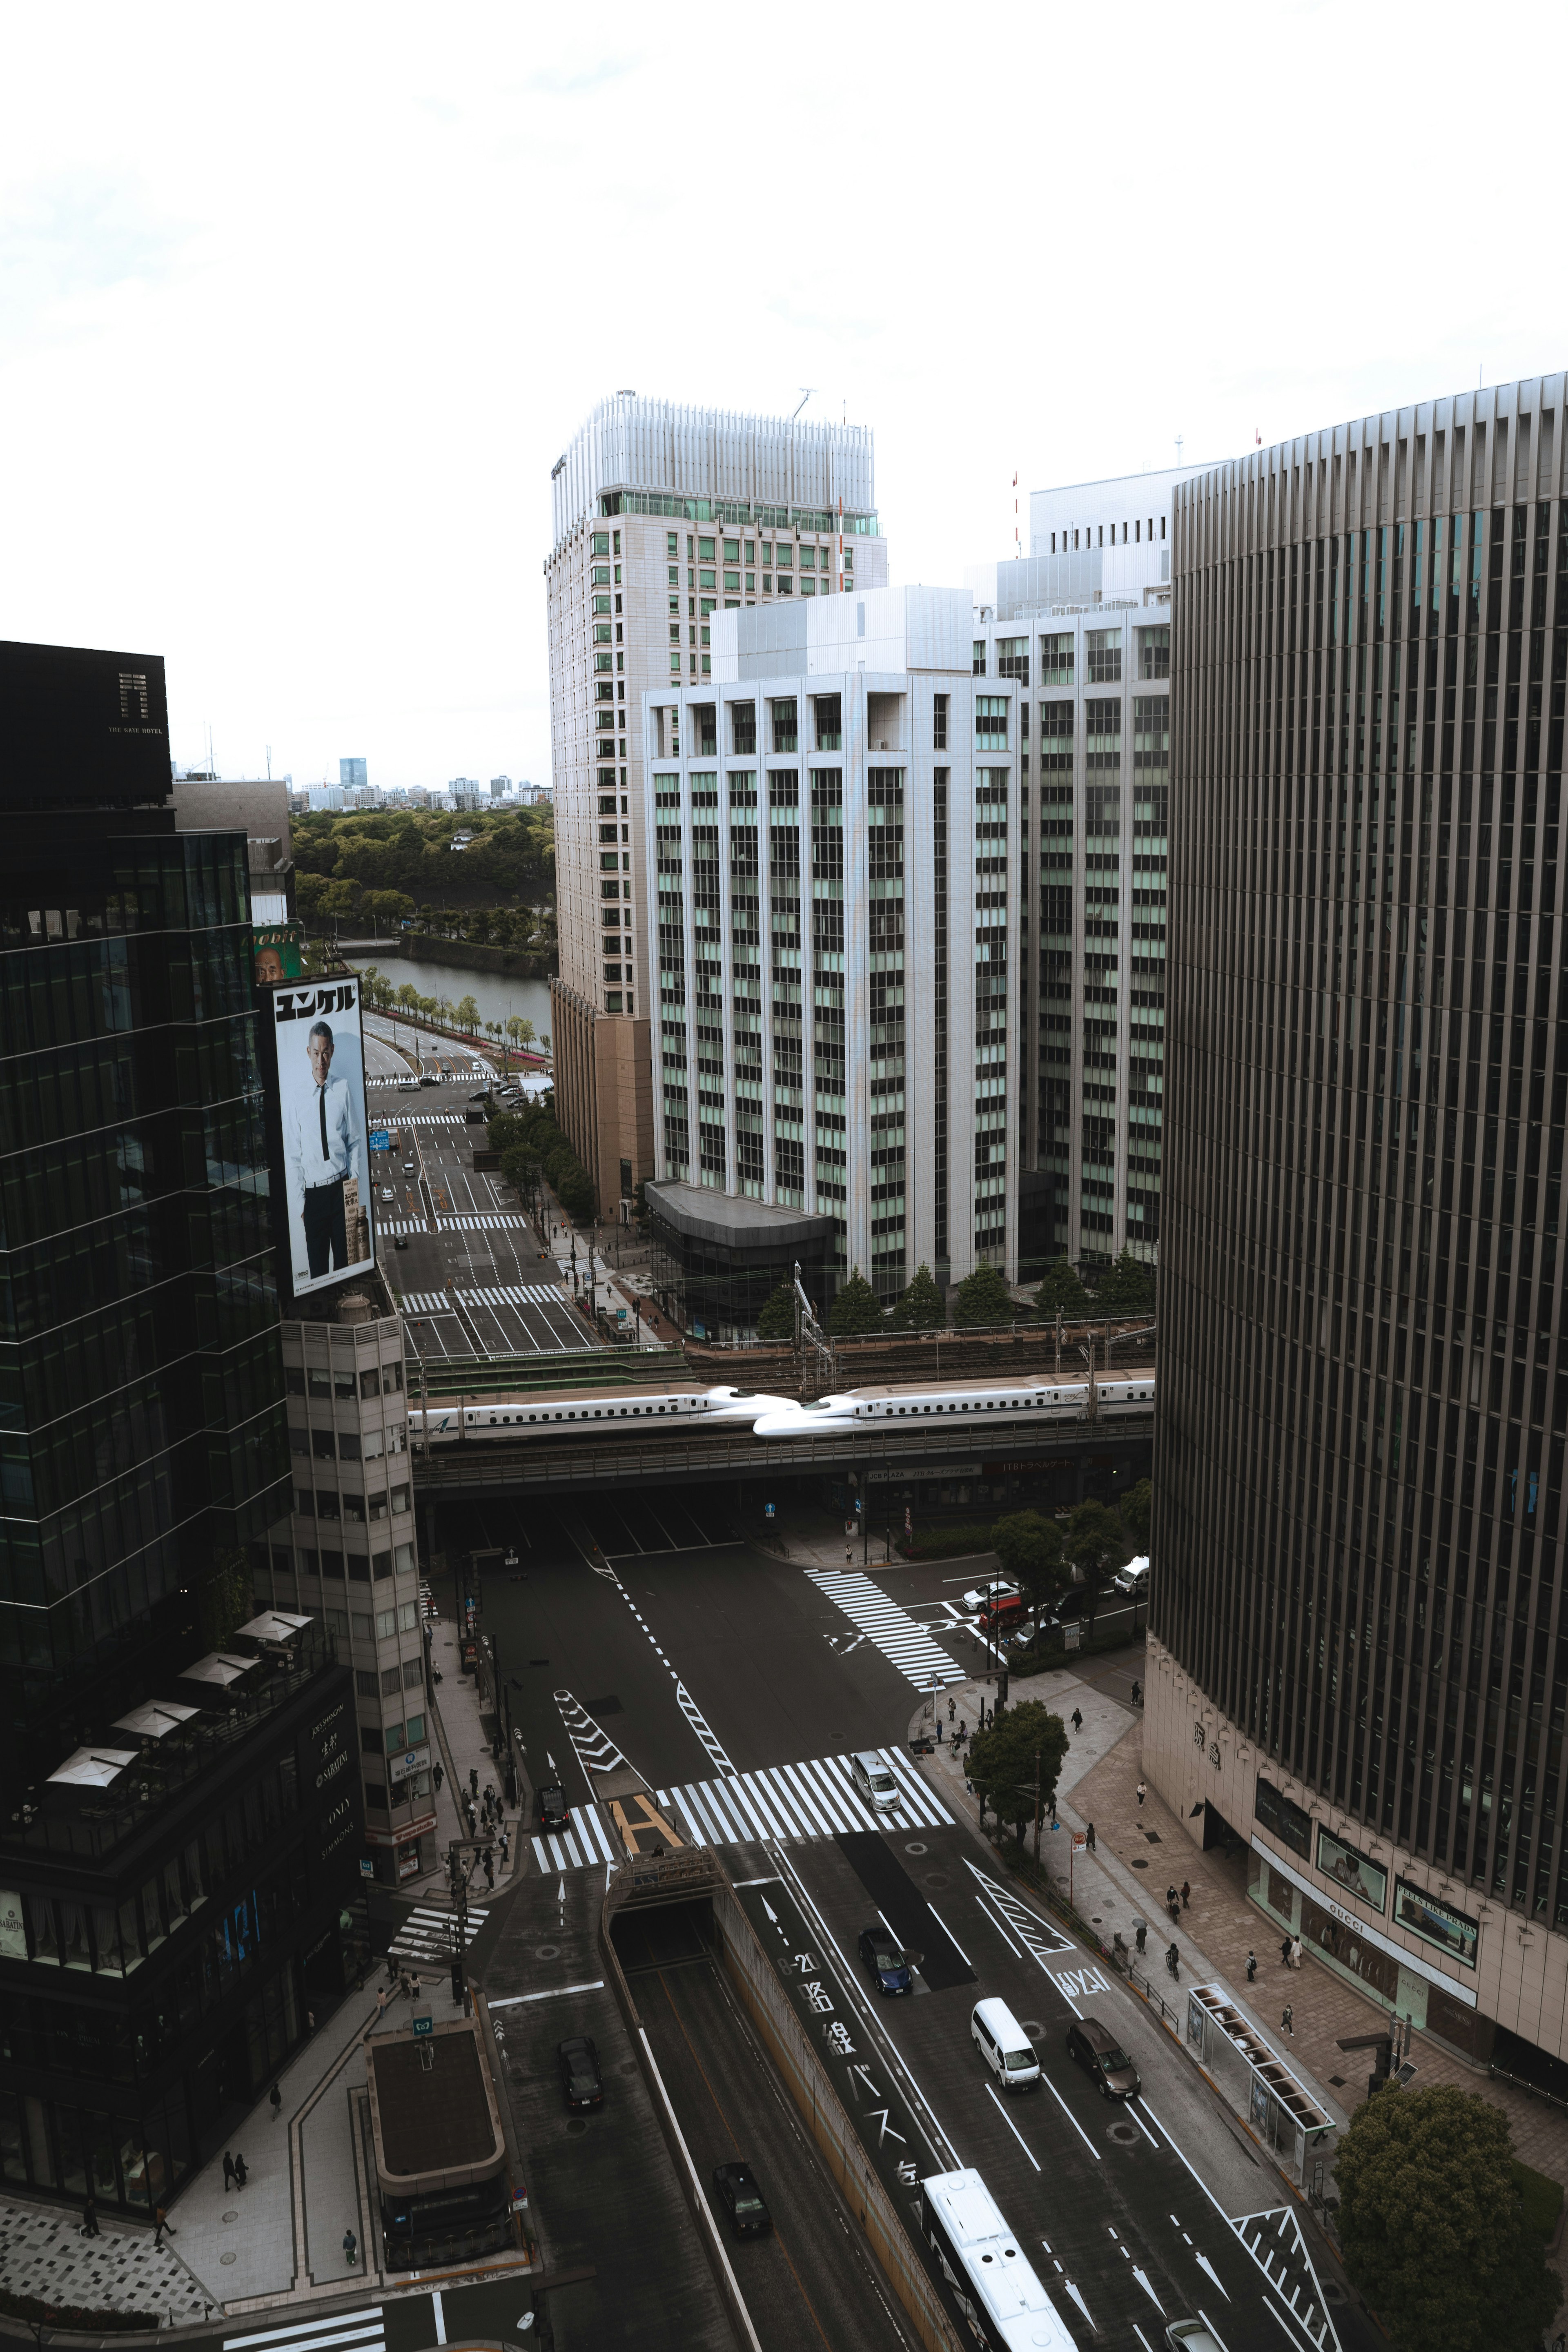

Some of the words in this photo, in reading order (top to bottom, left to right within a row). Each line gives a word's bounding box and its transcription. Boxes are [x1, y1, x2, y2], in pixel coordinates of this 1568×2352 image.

[276, 985, 356, 1022] ユンケル
[1194, 1722, 1221, 1771] 阪急
[324, 1750, 347, 1781] SABATINI
[329, 1797, 350, 1824] ONLY
[1263, 1801, 1278, 1817] BALENCIAGA
[322, 1822, 354, 1860] SIMMONS
[403, 1829, 416, 1838] vape
[416, 1820, 433, 1832] studio
[1288, 1823, 1304, 1838] BALENCIAGA
[1322, 1836, 1339, 1852] LOEWE
[1330, 1904, 1363, 1933] GUCCI
[1398, 1885, 1423, 1905] FEELS
[1425, 1901, 1444, 1918] LIKE
[1446, 1916, 1475, 1936] PRADA
[777, 1952, 821, 1976] 8-20
[1402, 1979, 1423, 1997] GUCCI
